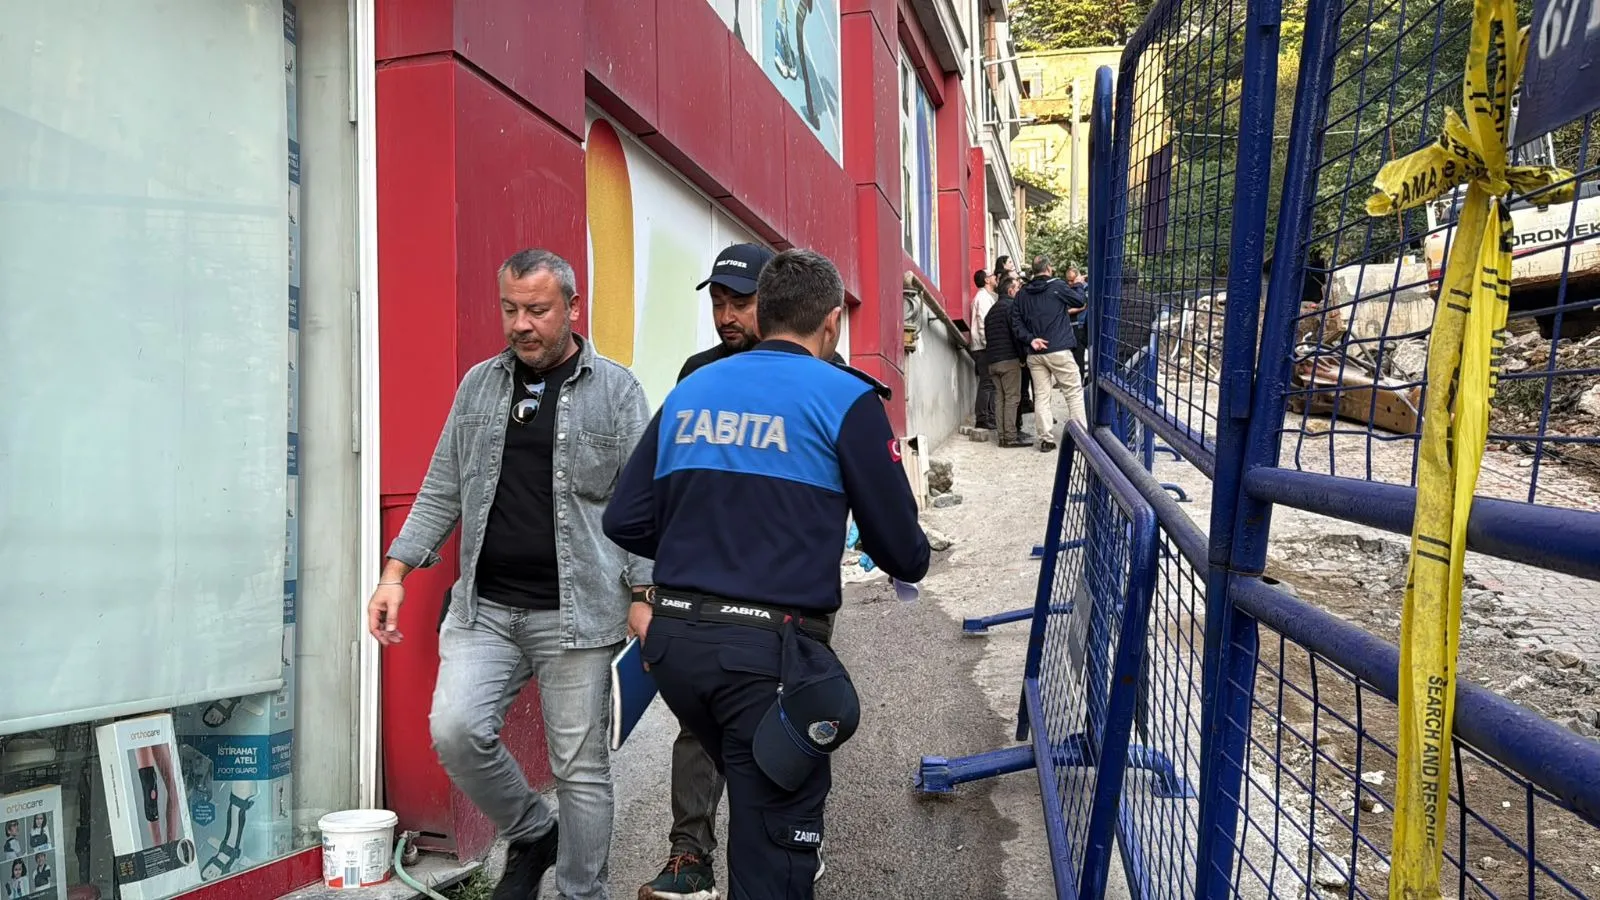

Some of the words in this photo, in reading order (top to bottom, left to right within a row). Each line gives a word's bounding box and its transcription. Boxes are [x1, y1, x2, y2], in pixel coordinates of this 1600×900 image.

[675, 409, 789, 453] ZABITA
[720, 605, 771, 619] ZABITA
[1425, 675, 1444, 740] SEARCH
[130, 729, 161, 741] orthocare
[1423, 742, 1440, 777] AND
[6, 799, 44, 814] orthocare
[794, 830, 821, 843] ZABITA
